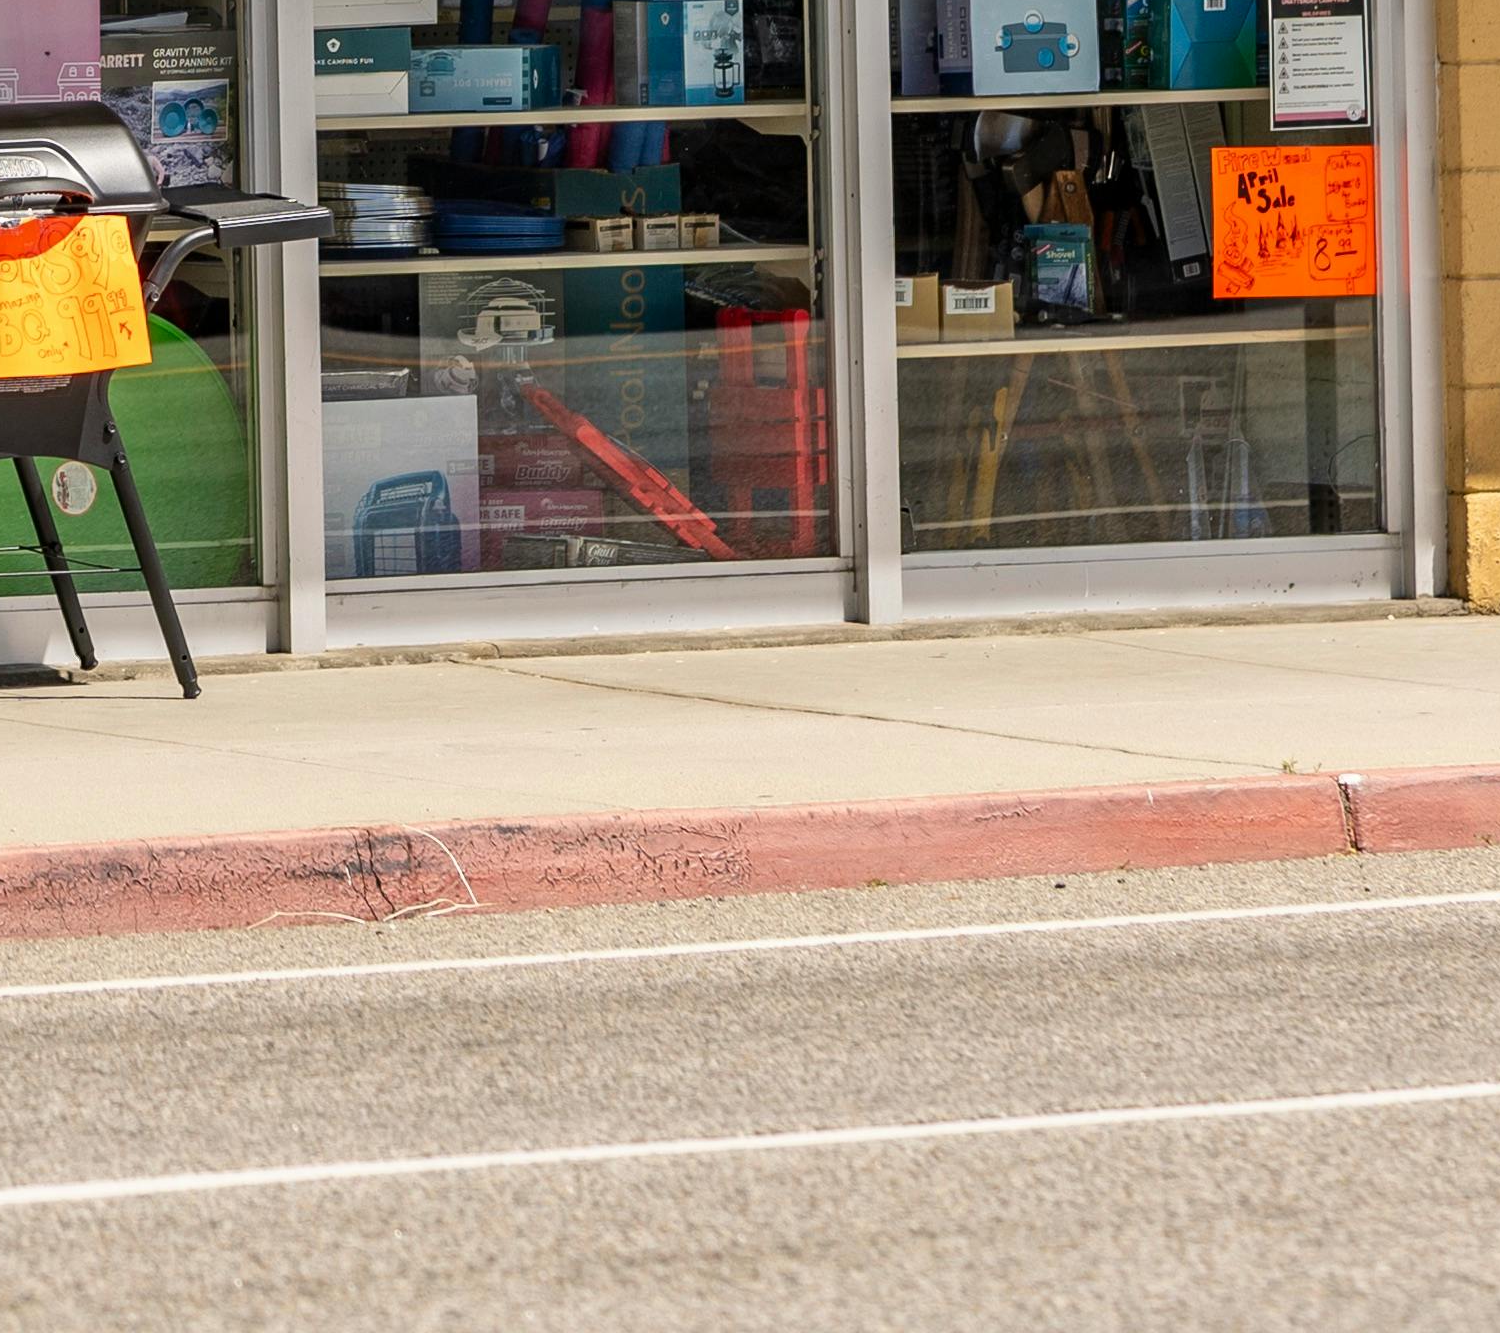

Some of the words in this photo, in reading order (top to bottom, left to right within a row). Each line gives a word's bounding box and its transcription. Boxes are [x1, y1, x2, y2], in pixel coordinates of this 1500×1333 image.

[152, 47, 191, 59] GRAVITY
[191, 46, 215, 56] TRAP
[99, 53, 145, 69] ARRETT
[152, 58, 180, 69] GOLD
[180, 57, 218, 68] PANNING
[1256, 184, 1296, 214] Sale
[1045, 250, 1076, 260] Shovel
[514, 463, 571, 483] Buddy
